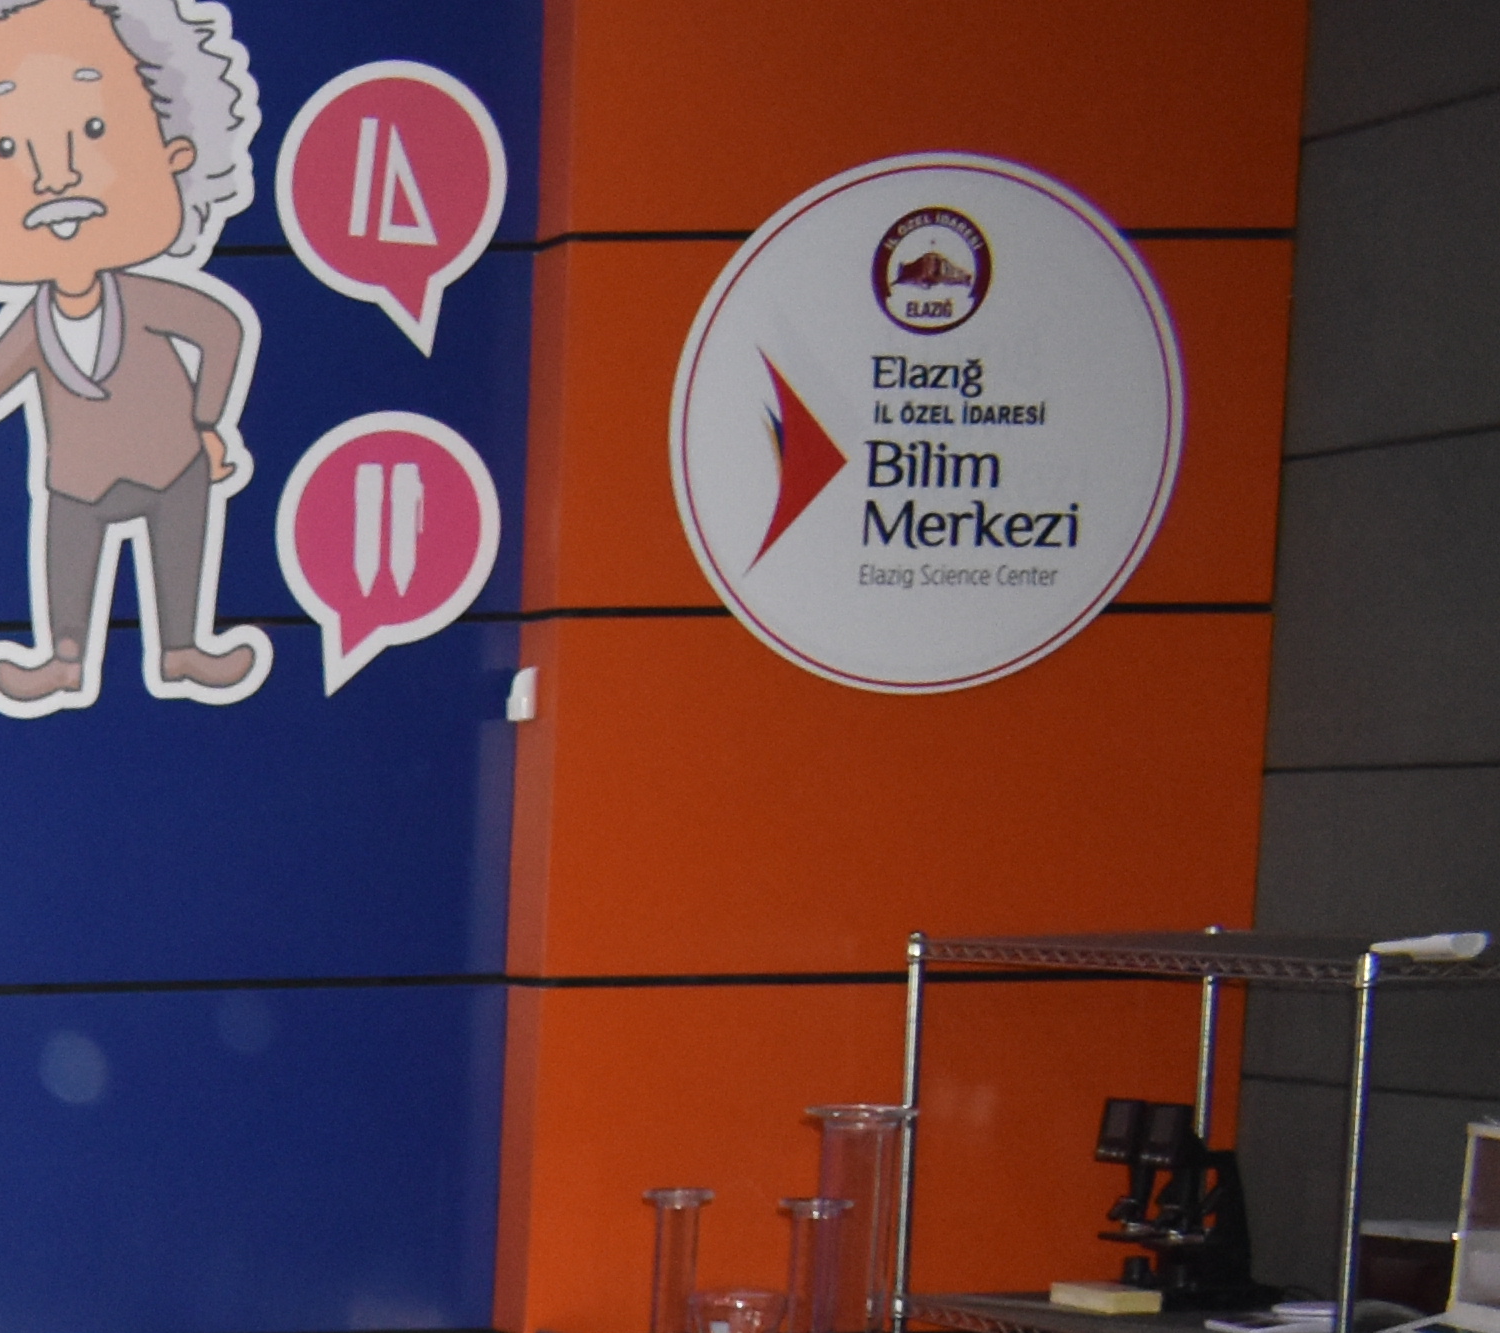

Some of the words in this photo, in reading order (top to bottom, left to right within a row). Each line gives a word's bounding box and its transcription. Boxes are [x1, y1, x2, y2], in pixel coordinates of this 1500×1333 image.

[871, 355, 984, 398] Elazığ
[874, 402, 893, 425] İL
[901, 402, 955, 425] ÖZEL
[962, 400, 1046, 425] İDARESİ
[865, 439, 1000, 489] Bilim
[862, 500, 1079, 549] Merkezi
[920, 564, 991, 586] Science
[996, 565, 1058, 586] Center
